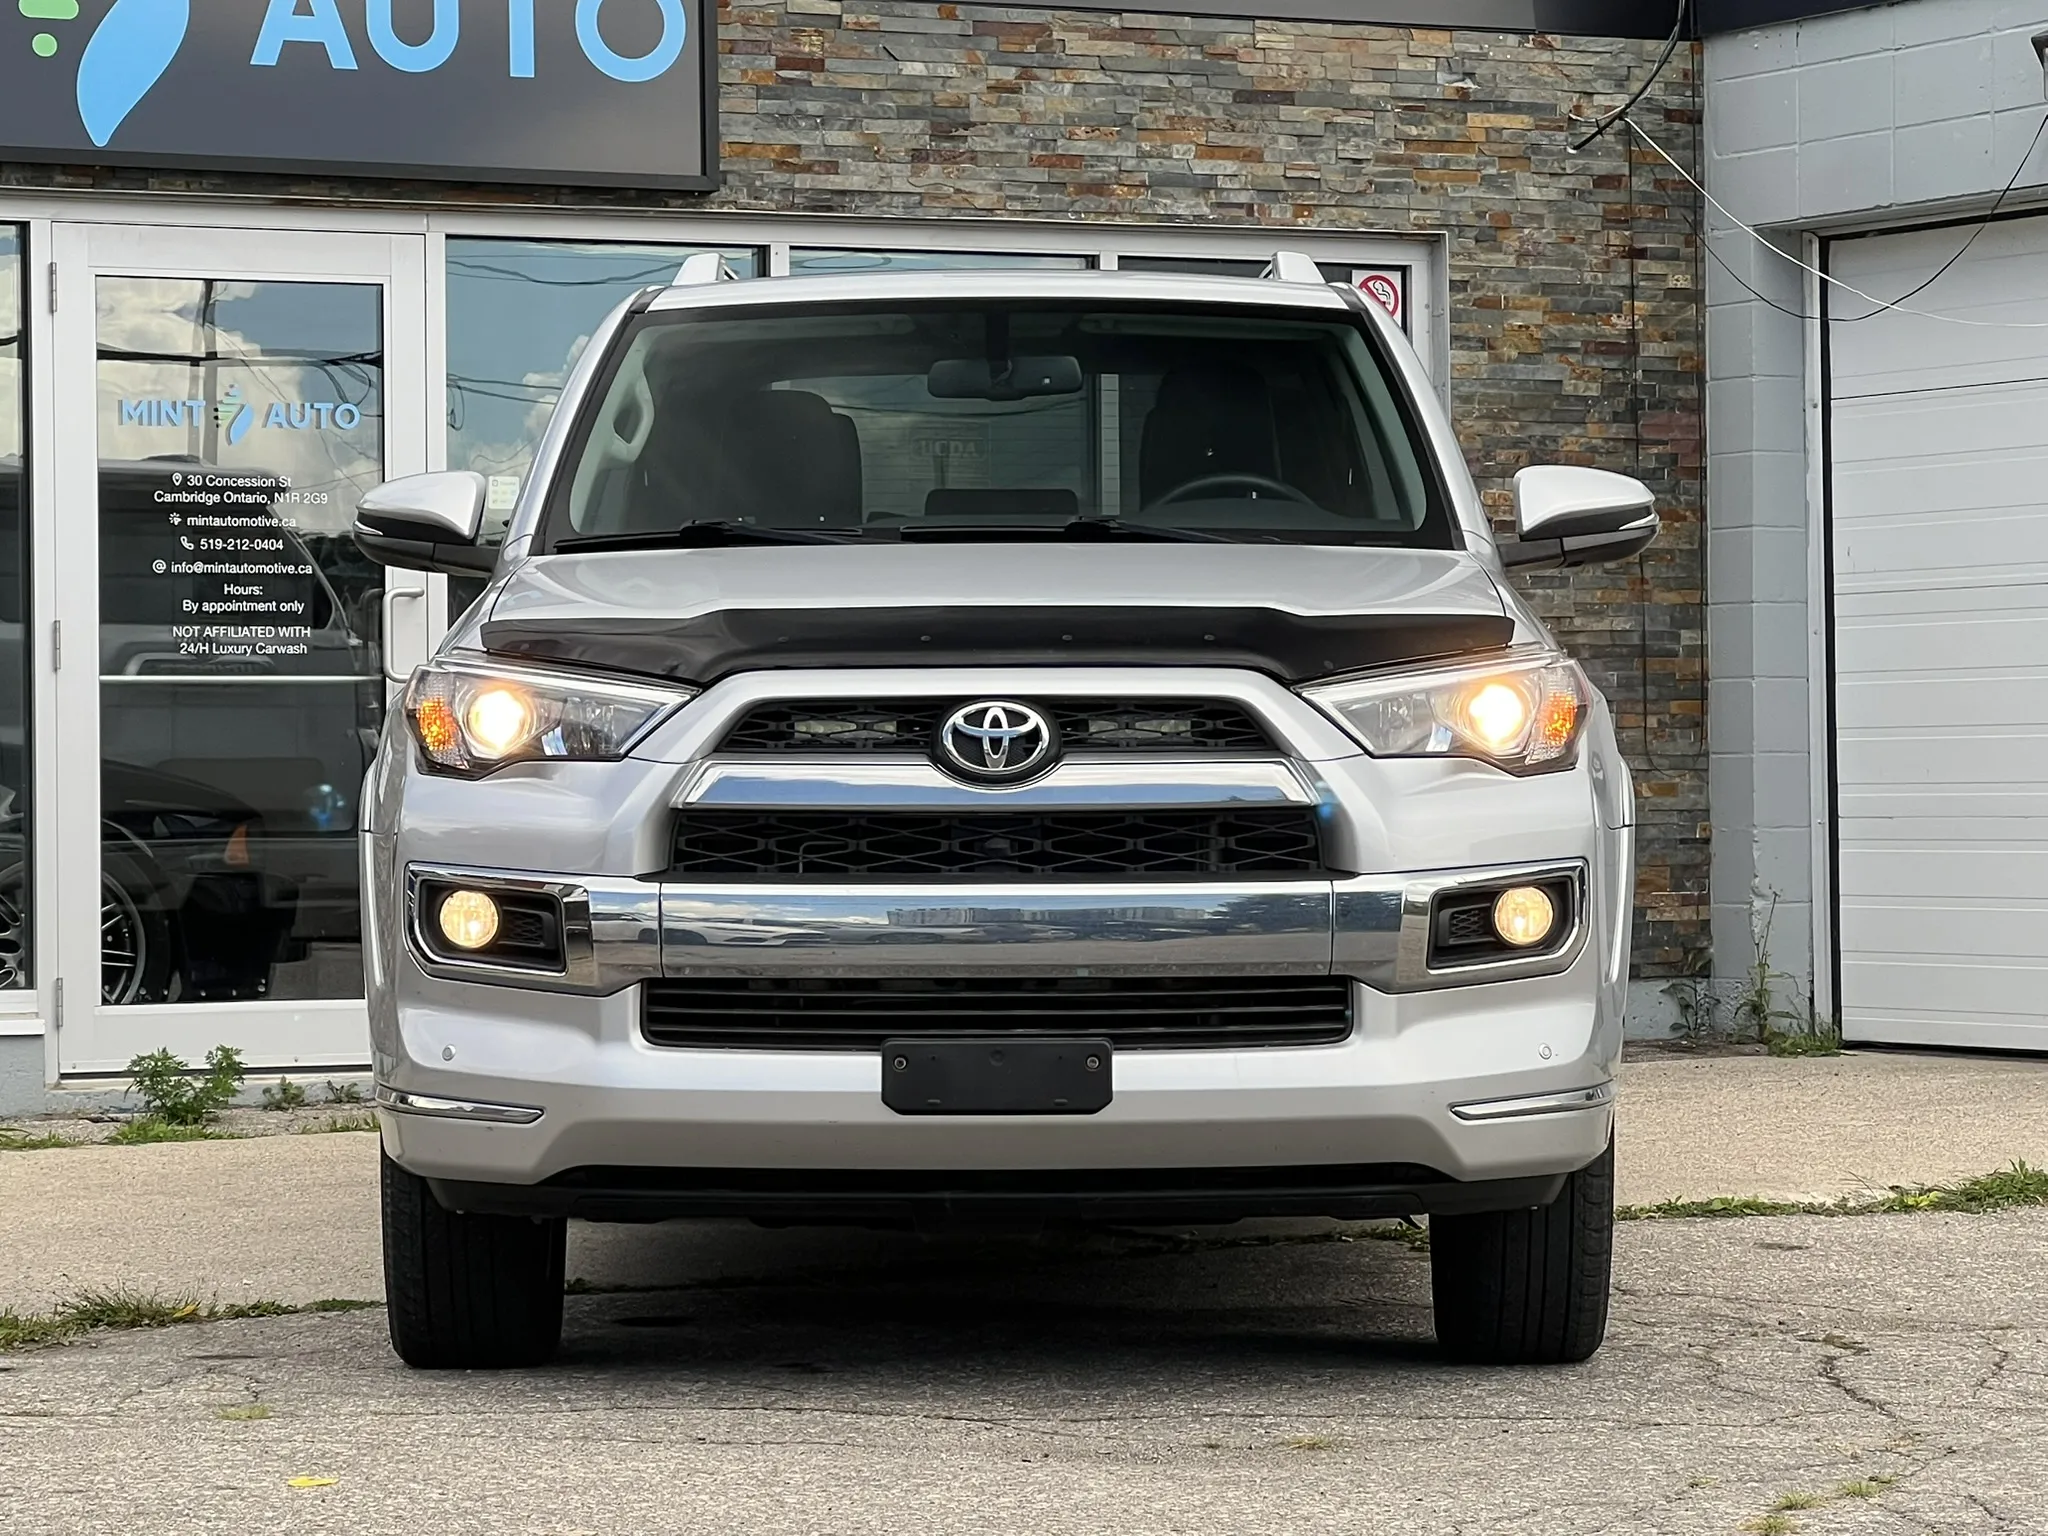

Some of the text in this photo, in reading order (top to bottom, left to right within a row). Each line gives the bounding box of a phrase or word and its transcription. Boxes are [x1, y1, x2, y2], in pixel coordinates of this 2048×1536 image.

[121, 399, 361, 430] MINT AUTO
[186, 474, 292, 488] 30 Concession St
[153, 490, 328, 506] Cambridge Ontario, N1R 2G9
[186, 514, 297, 528] mintautomotive.ca
[199, 538, 284, 551] 519-212-0404
[170, 561, 313, 575] info@mintautomotive.ca
[223, 583, 264, 596] Hours:
[182, 599, 305, 615] By appointment only
[172, 625, 311, 638] NOT AFFILIATED WITH
[179, 642, 308, 657] 24/H Luxury Carwash
